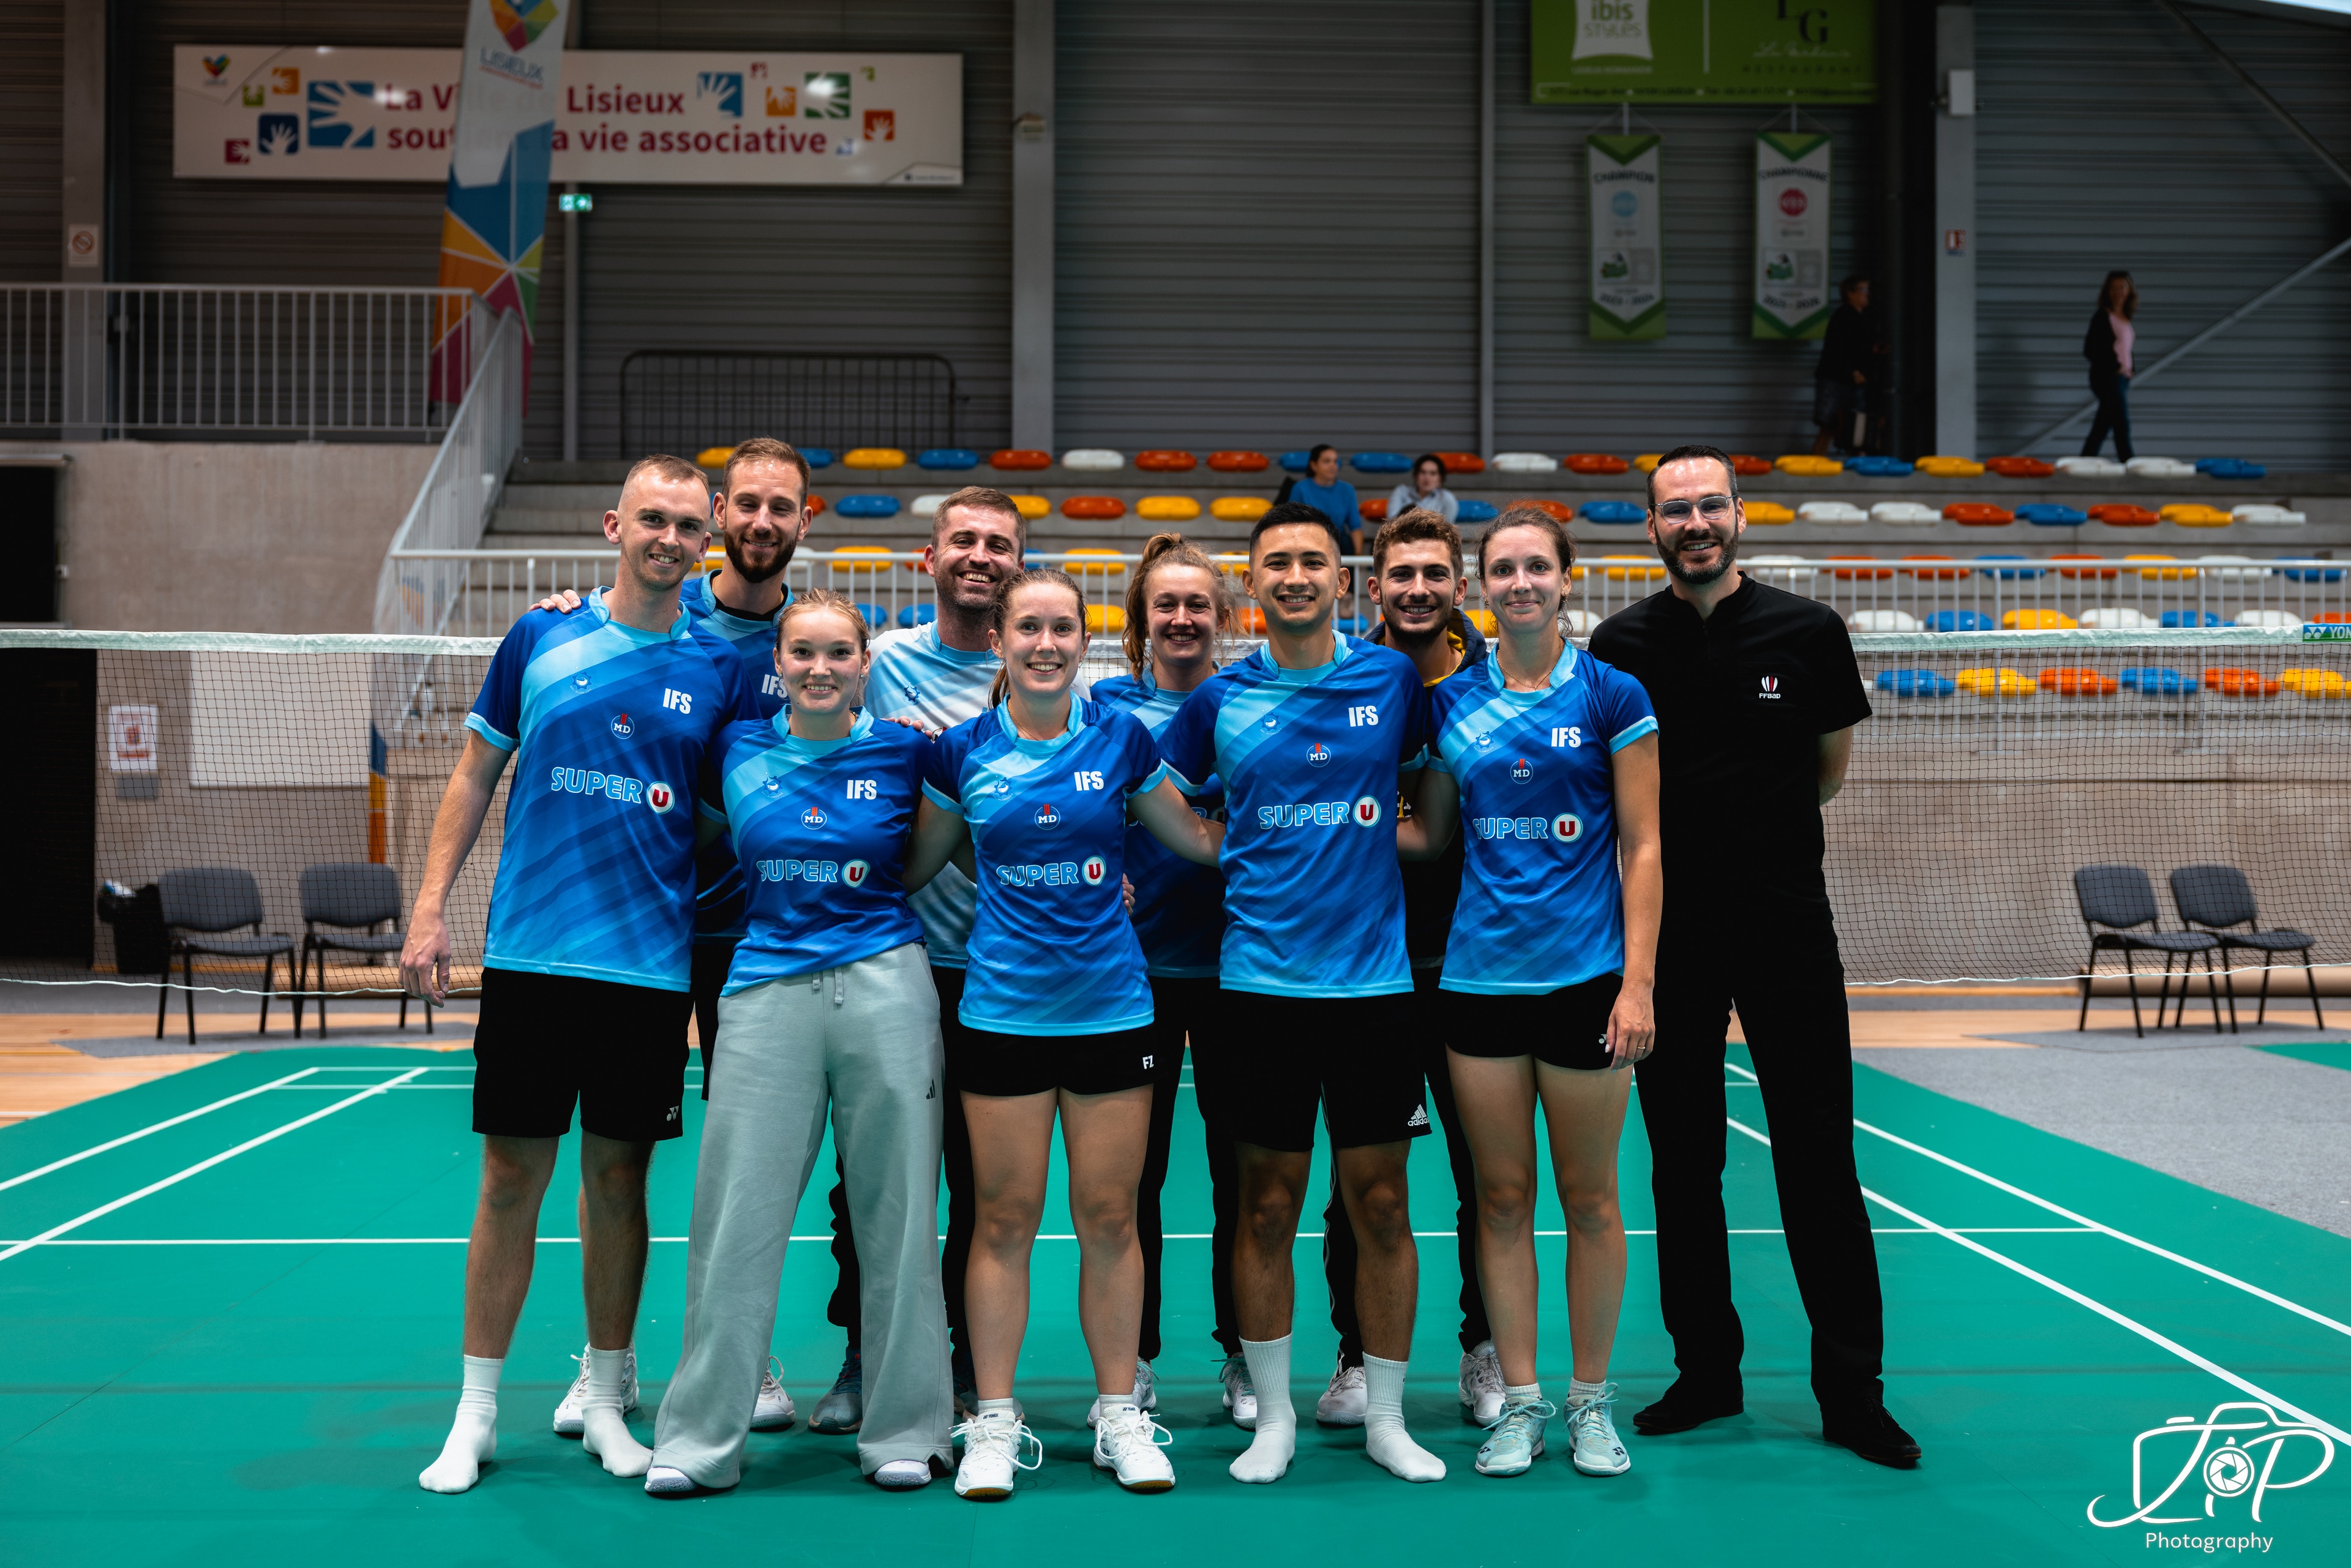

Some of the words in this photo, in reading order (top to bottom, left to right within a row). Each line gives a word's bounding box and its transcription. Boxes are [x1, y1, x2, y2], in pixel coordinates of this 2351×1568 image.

[1591, 0, 1633, 20] ibis
[567, 84, 685, 114] Lisieux
[551, 129, 568, 151] a
[579, 124, 628, 151] vie
[639, 125, 827, 154] associative
[662, 688, 692, 714] IFS
[1348, 705, 1379, 727] IFS
[613, 722, 631, 733] MD
[1551, 727, 1581, 748] IFS
[1310, 752, 1328, 761] MD
[1074, 770, 1104, 792] IFS
[1513, 769, 1530, 778] MD
[551, 767, 643, 804] SUPER
[847, 779, 877, 800] IFS
[1038, 815, 1057, 823] MD
[1258, 801, 1349, 830] SUPER
[1472, 817, 1549, 840] SUPER
[756, 858, 838, 883] SUPER
[996, 861, 1079, 887] SUPER
[1408, 1117, 1429, 1127] adidas
